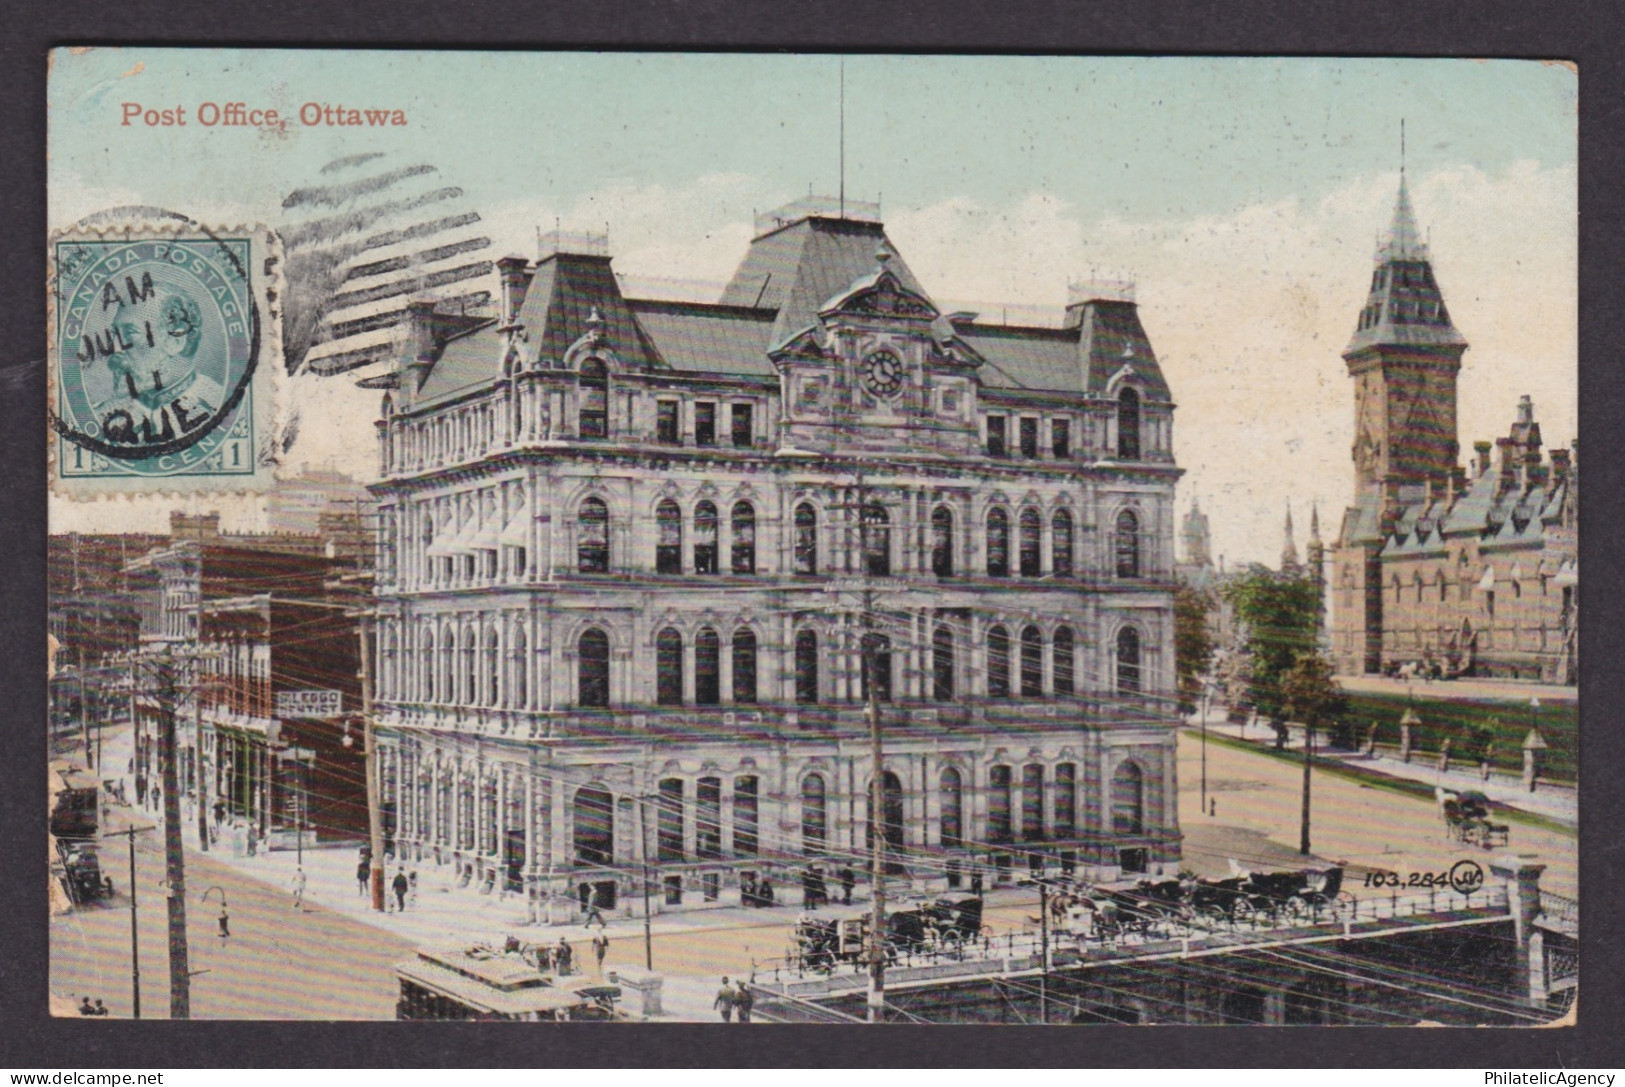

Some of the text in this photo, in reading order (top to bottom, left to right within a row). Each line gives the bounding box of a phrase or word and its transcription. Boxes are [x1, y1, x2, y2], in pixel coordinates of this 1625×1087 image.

[120, 101, 408, 132] Post Office, Ottawa
[66, 250, 141, 340] CANADA
[154, 244, 243, 337] POSTAGE
[103, 271, 155, 311] AM
[76, 326, 134, 362] JUL
[73, 444, 84, 469] 1
[230, 441, 241, 466] 1
[1364, 871, 1448, 889] 103,284
